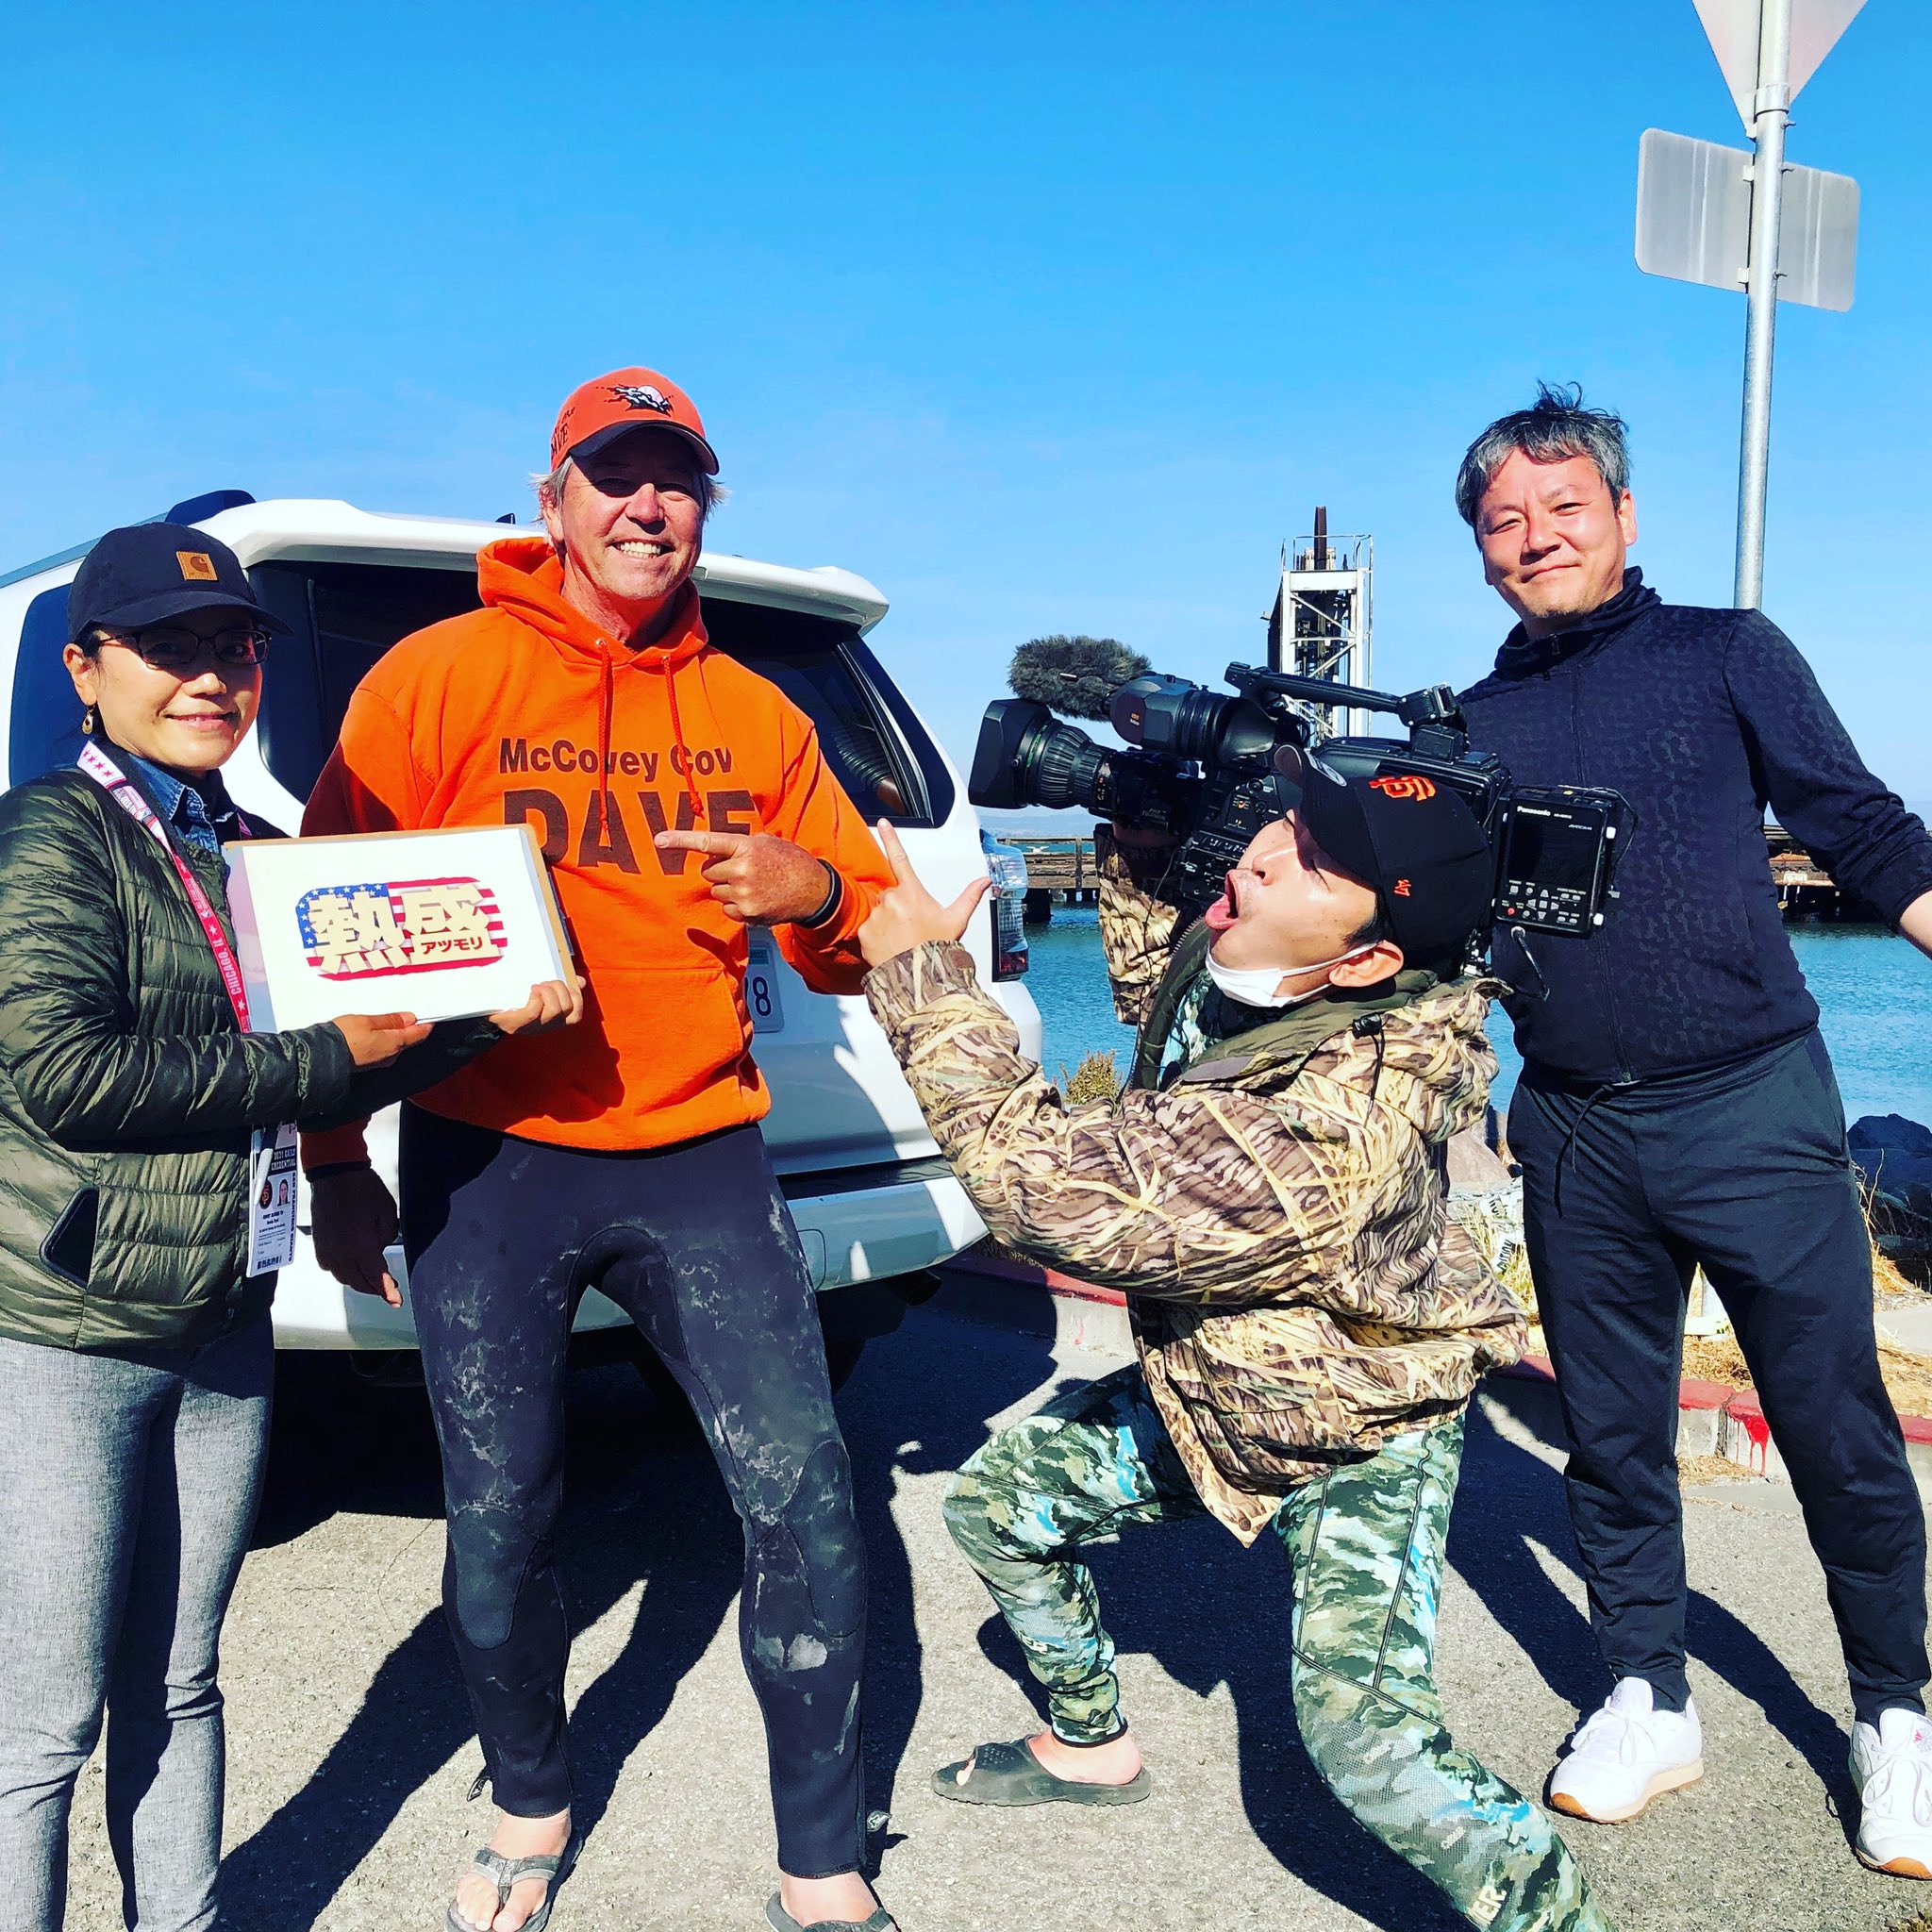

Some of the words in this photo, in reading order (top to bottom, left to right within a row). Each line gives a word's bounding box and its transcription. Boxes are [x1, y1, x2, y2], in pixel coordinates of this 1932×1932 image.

[500, 738, 658, 782] McCovey
[1517, 806, 1551, 817] Panasonic
[421, 937, 484, 955] アツモリ
[744, 976, 772, 1017] 8
